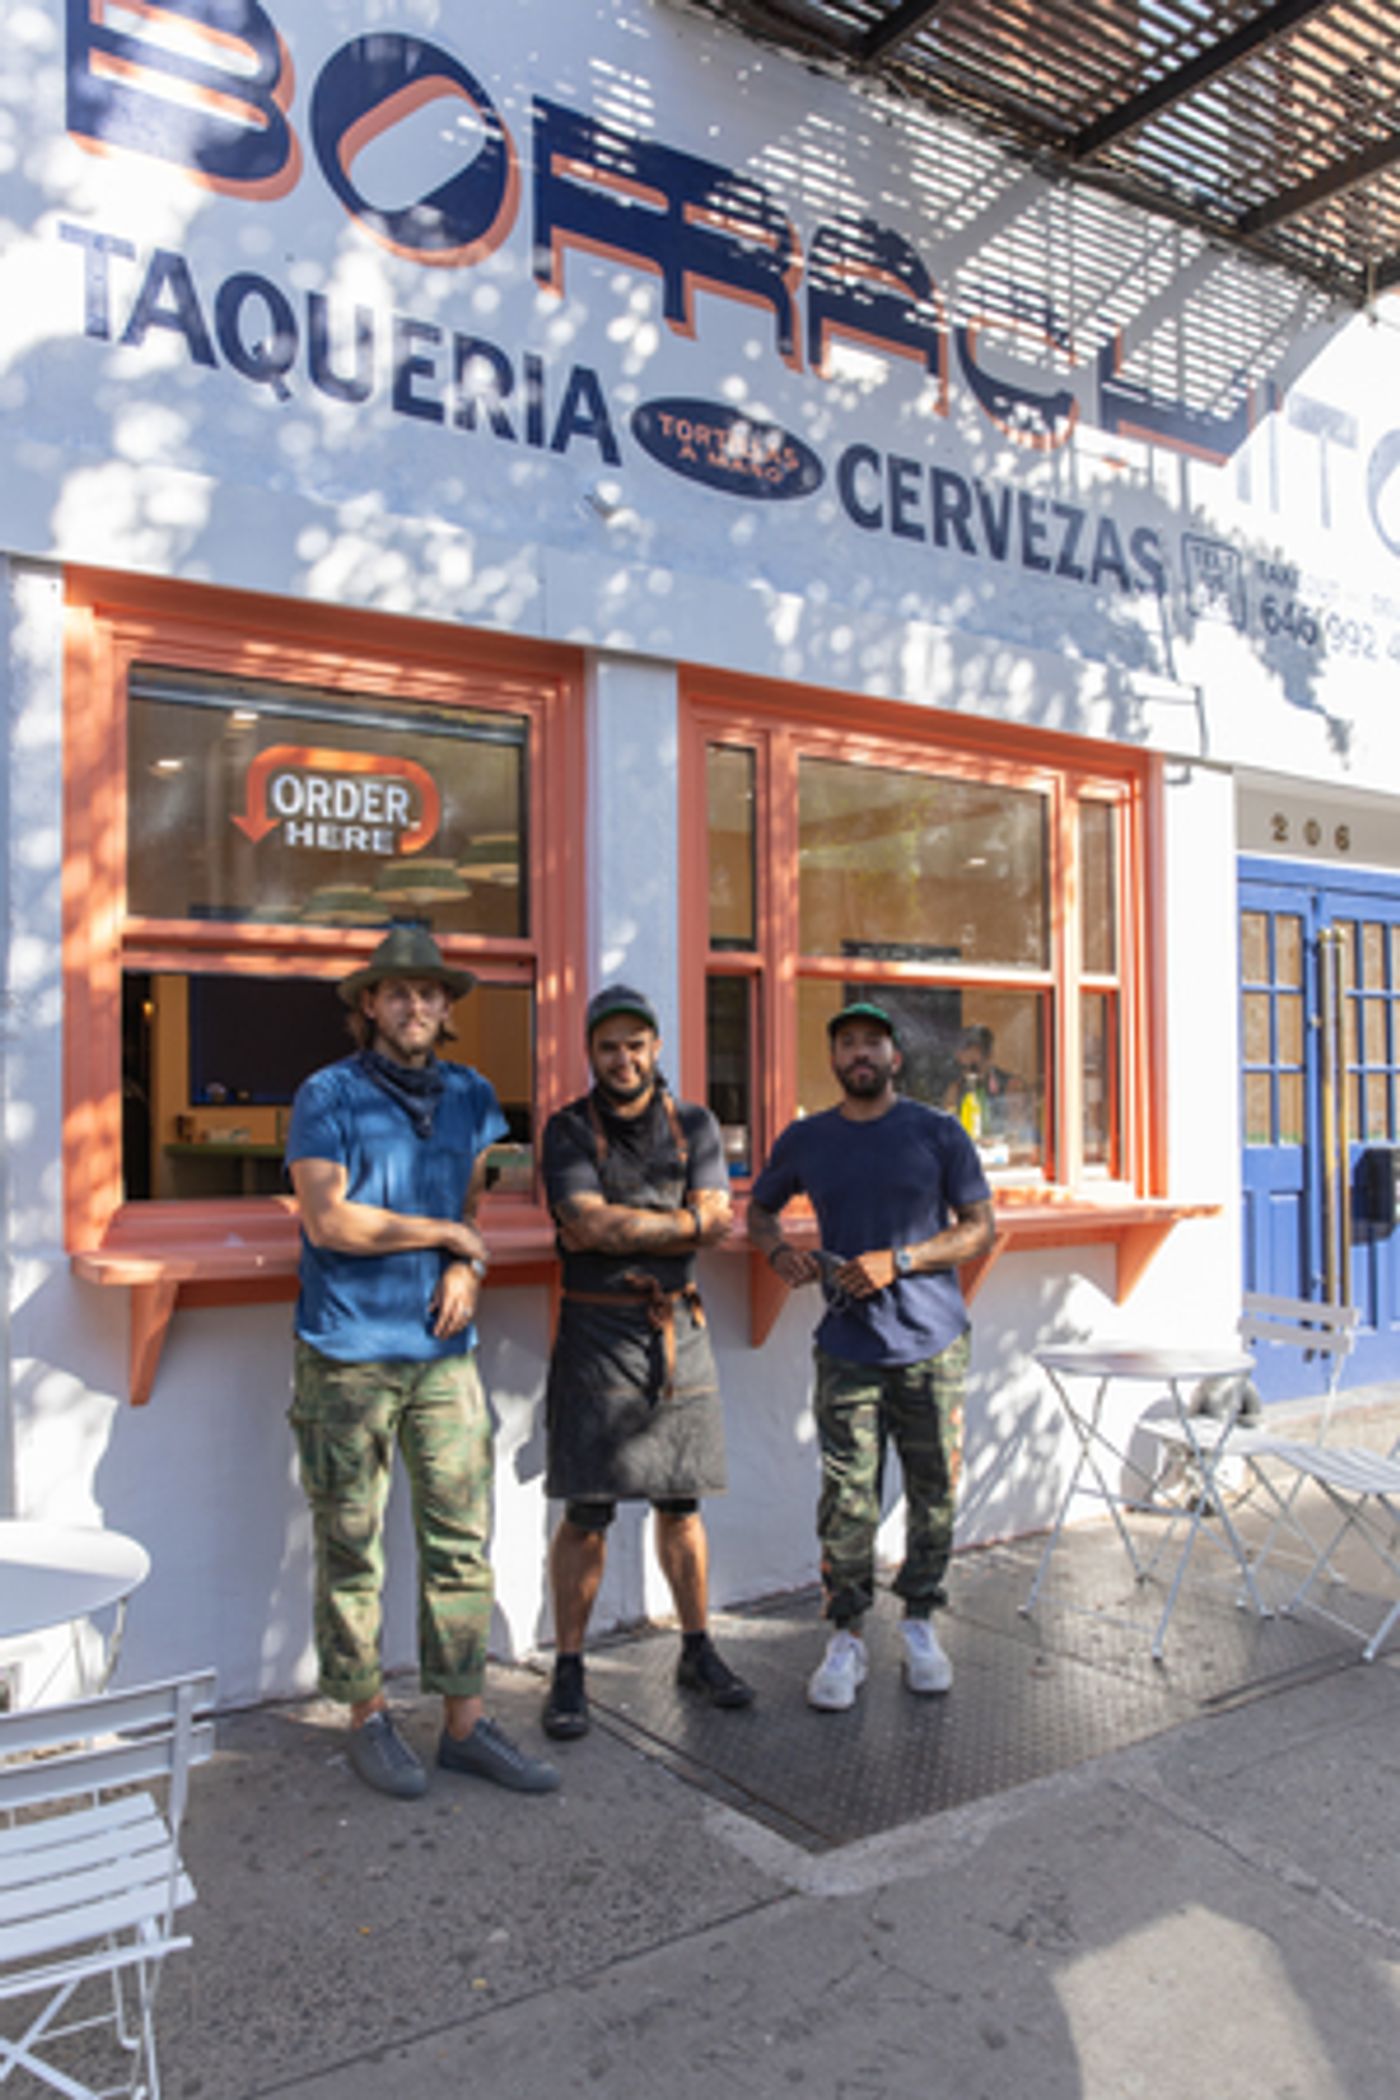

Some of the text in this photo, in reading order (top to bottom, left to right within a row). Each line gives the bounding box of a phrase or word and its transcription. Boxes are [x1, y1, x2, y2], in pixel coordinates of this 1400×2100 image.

[58, 220, 622, 467] TAQUERIA
[677, 444, 698, 463] A
[835, 443, 1167, 598] CERVEZAS
[1260, 594, 1320, 646] 646
[272, 774, 410, 826] ORDER
[286, 821, 395, 856] HERE
[1270, 812, 1350, 851] 206
